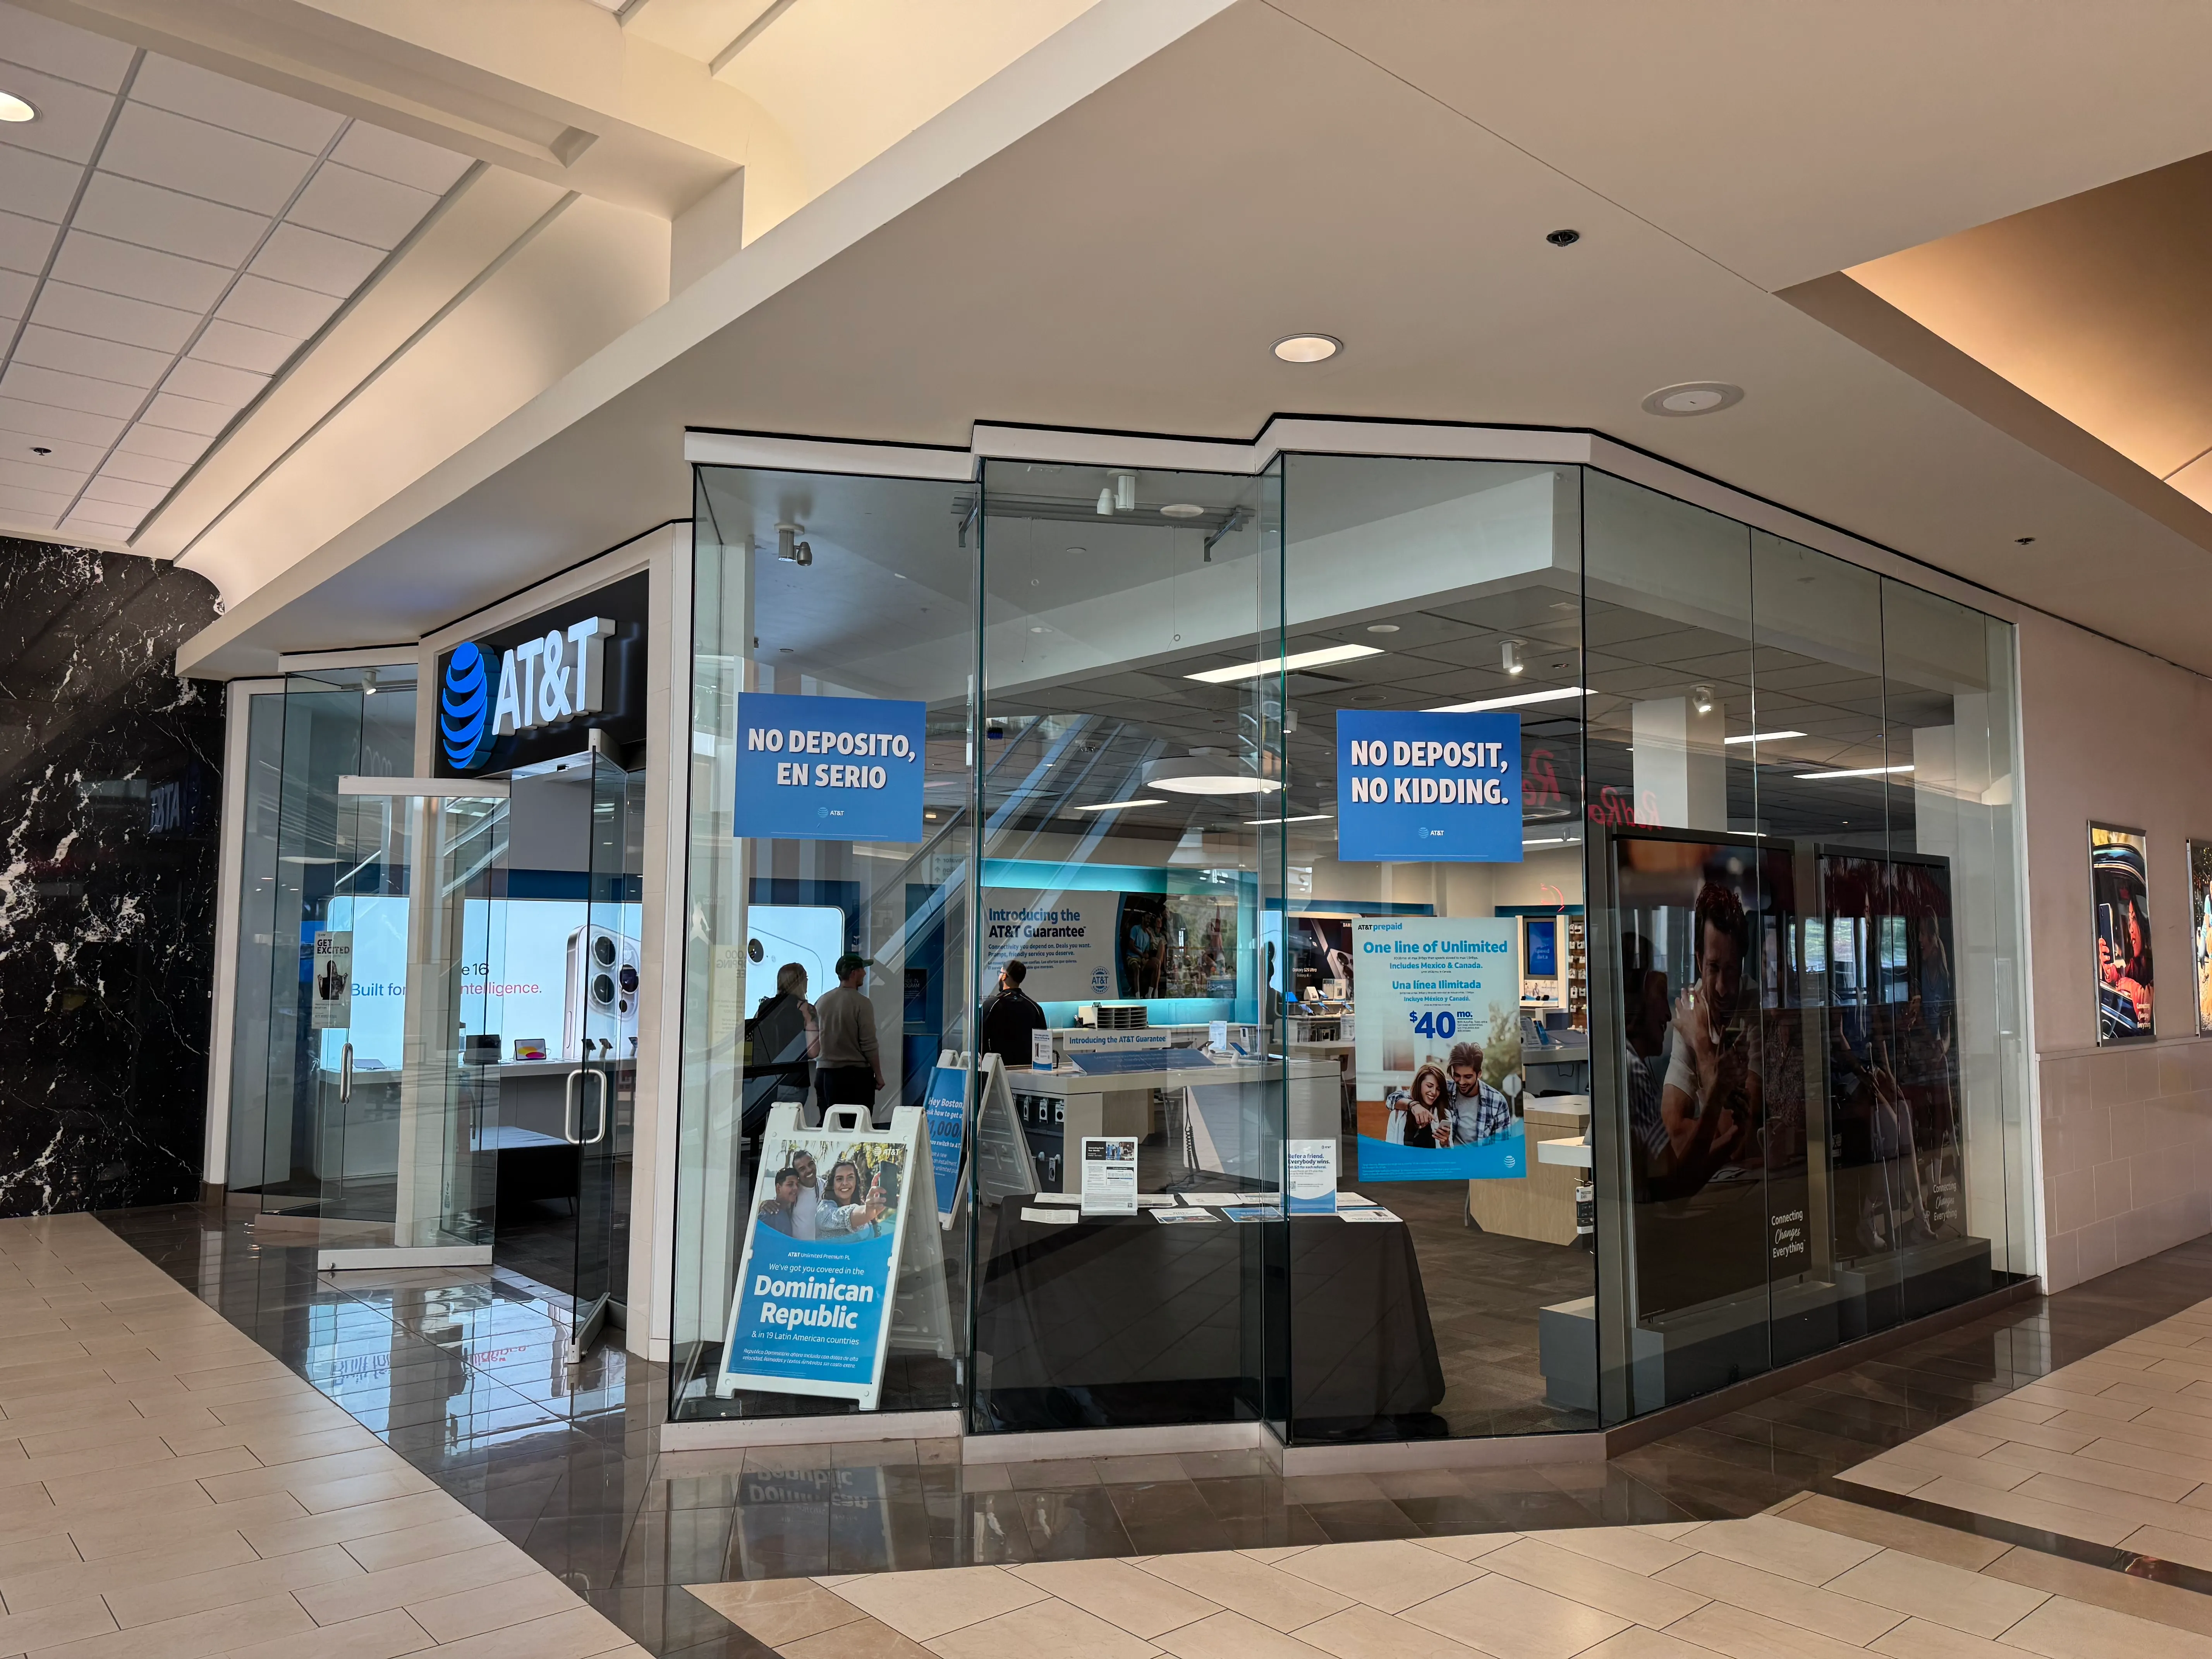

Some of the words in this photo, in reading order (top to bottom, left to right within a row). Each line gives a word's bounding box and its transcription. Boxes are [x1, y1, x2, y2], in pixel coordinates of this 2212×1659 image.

[492, 616, 600, 735] AT&T
[748, 728, 783, 752] NO
[789, 730, 915, 762] DEPOSITO,
[1352, 740, 1387, 766] NO
[1393, 741, 1508, 773] DEPOSIT,
[777, 763, 808, 785] EN
[815, 764, 886, 788] SERIO
[1352, 777, 1388, 802] NO
[1395, 778, 1508, 804] KIDDING.
[989, 908, 1058, 924] Introducing
[1061, 908, 1080, 921] the
[989, 926, 1021, 938] AT&T
[1373, 923, 1402, 931] prepaid
[1364, 941, 1391, 953] One
[1395, 941, 1419, 953] line
[1423, 940, 1438, 953] of
[1441, 940, 1508, 953] Unlimited
[473, 963, 489, 975] 16
[351, 983, 384, 996] Built
[460, 982, 542, 997] ntelligence.
[1392, 981, 1411, 989] Una
[1413, 980, 1436, 989] línea
[1439, 980, 1481, 989] Ilimitada
[1410, 1010, 1455, 1039] $40
[1070, 1036, 1106, 1045] Introducing
[928, 1097, 941, 1108] Hey
[941, 1098, 963, 1109] Boston,
[1933, 1181, 1956, 1193] Connecting
[1936, 1195, 1954, 1209] Changes
[1771, 1209, 1803, 1226] Connecting
[1934, 1208, 1957, 1221] Everything
[1775, 1228, 1800, 1244] Changes
[1773, 1241, 1803, 1258] Everything
[816, 1266, 843, 1274] covered
[754, 1275, 874, 1302] Dominican
[760, 1302, 858, 1330] Republic
[792, 1334, 825, 1342] American
[826, 1336, 859, 1345] countries
